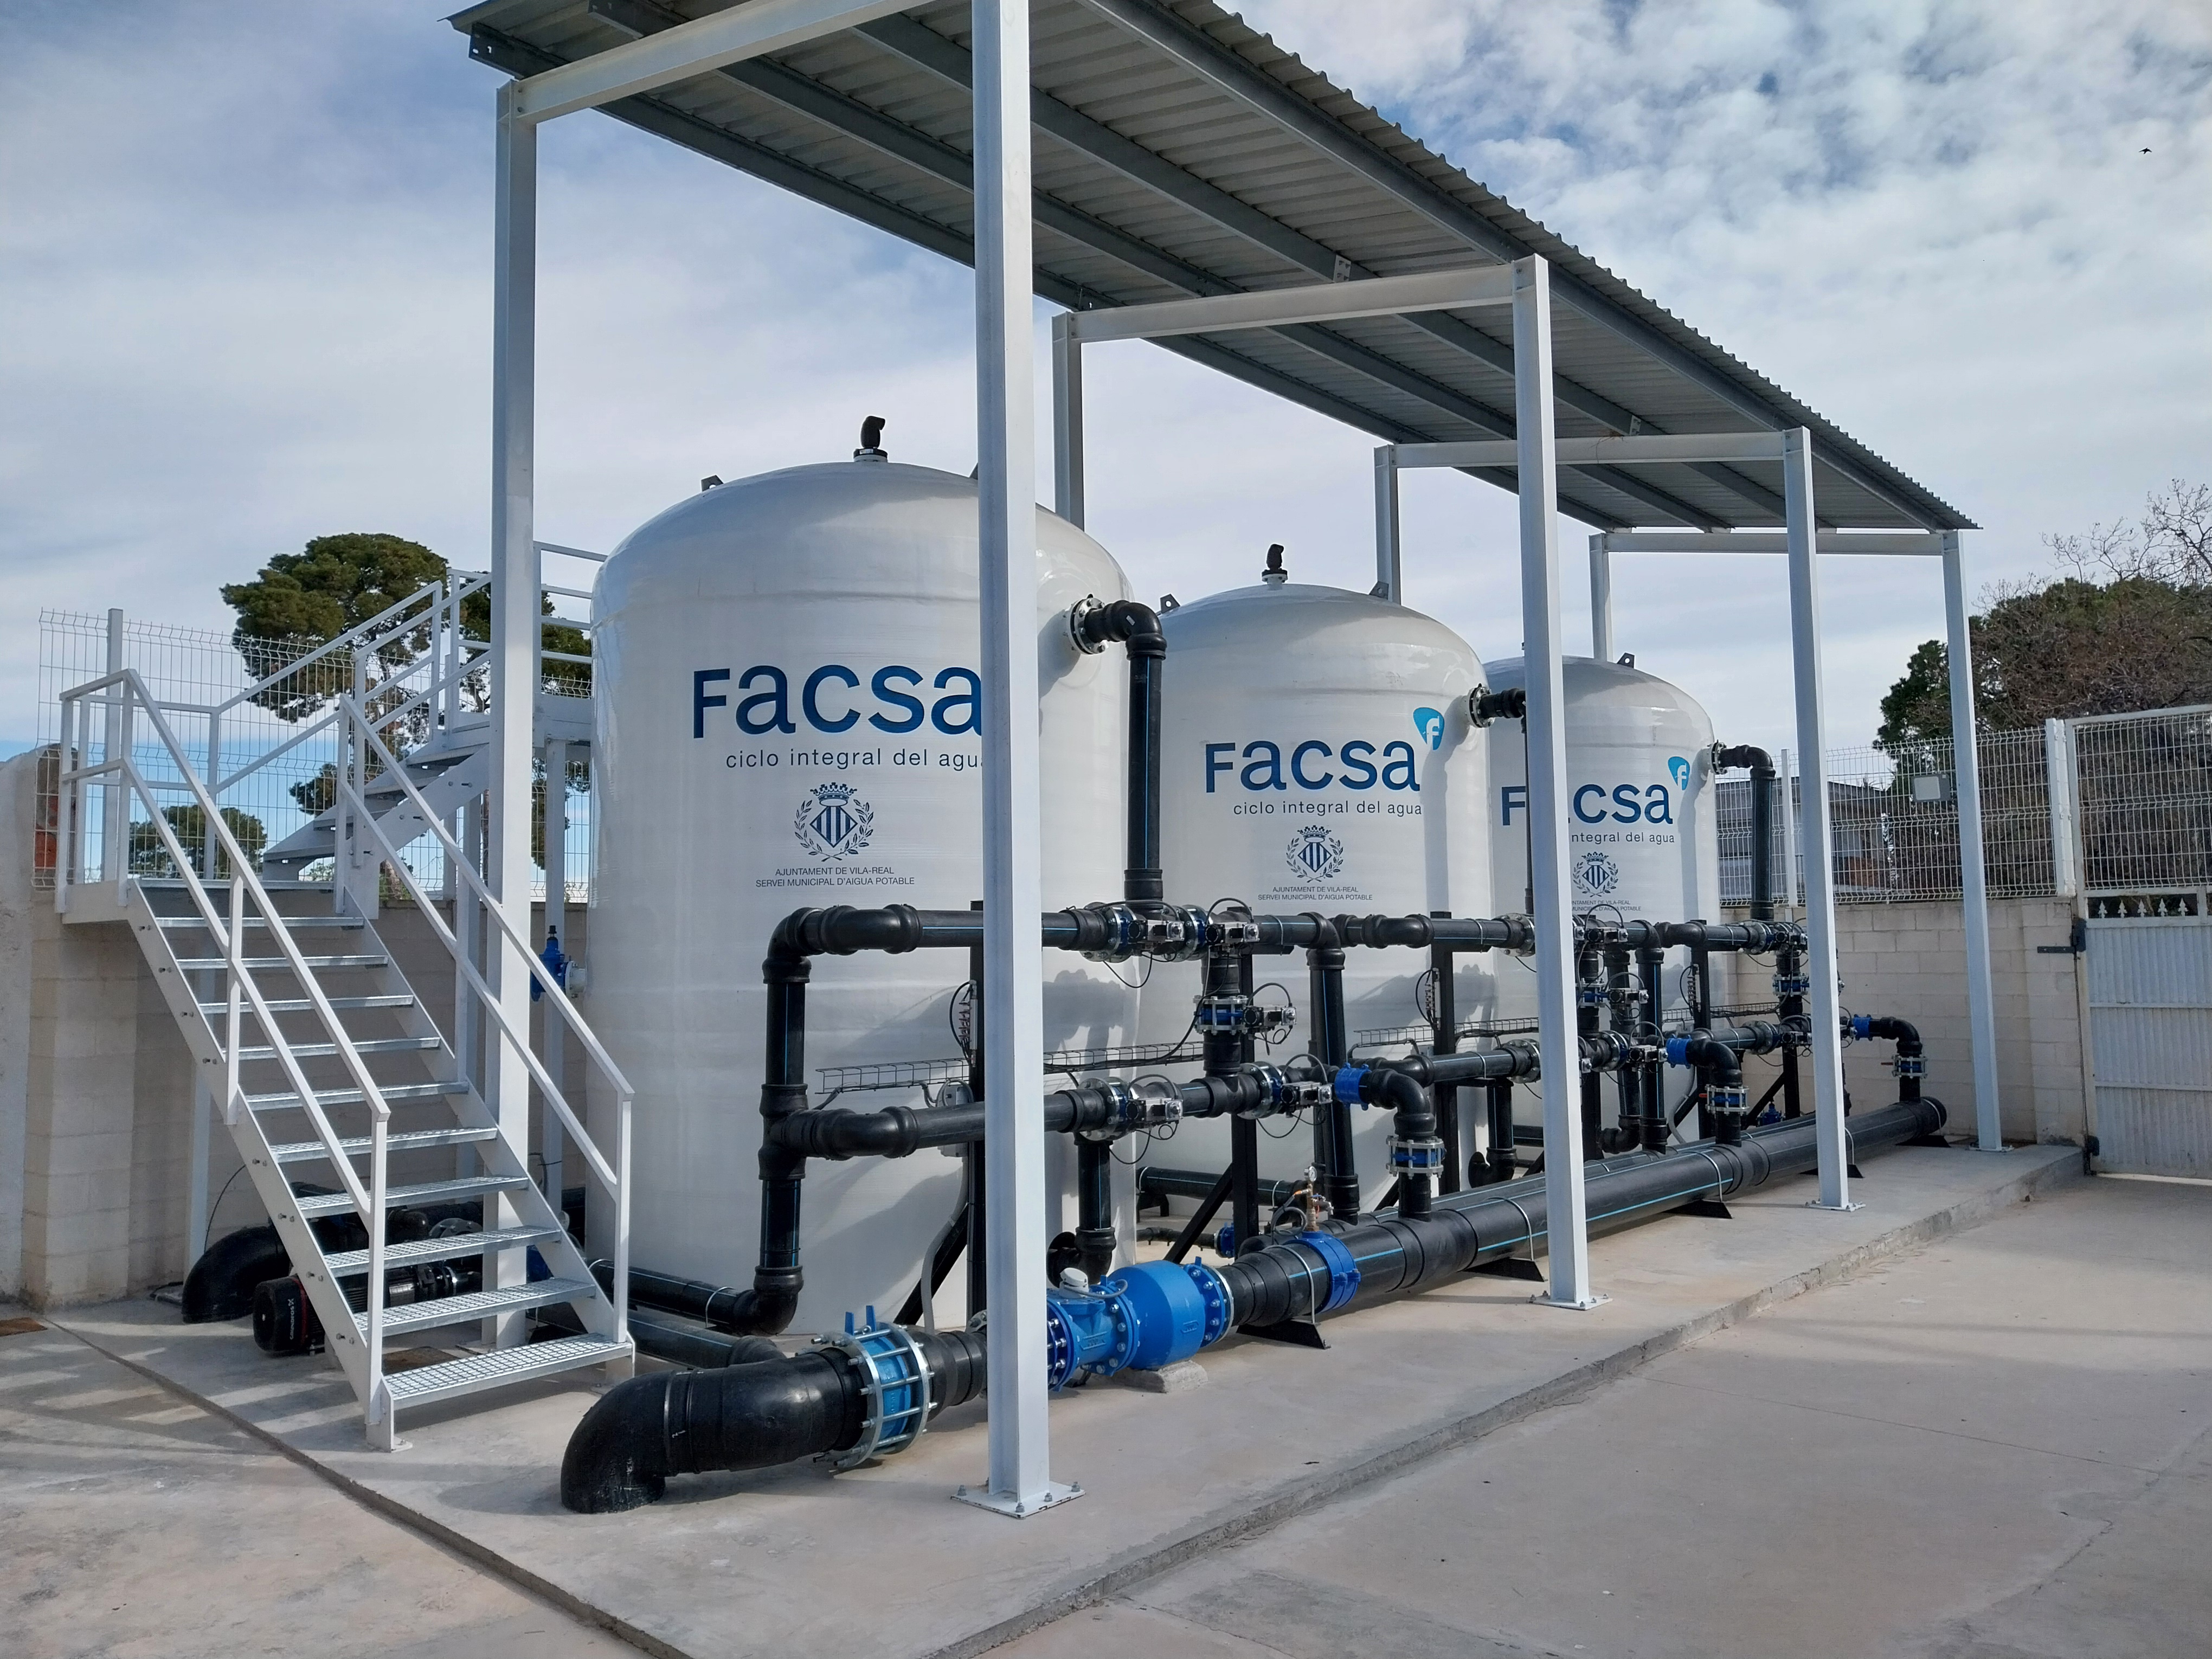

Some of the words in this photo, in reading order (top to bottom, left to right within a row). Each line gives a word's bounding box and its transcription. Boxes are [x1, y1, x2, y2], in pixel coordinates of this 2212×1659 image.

[693, 665, 981, 738] Facsa
[726, 749, 779, 768] ciclo
[790, 748, 880, 770] integral
[893, 748, 927, 766] del
[938, 754, 982, 771] agu
[1205, 740, 1420, 793] Facsa
[1233, 801, 1274, 815] ciclo
[1283, 800, 1348, 816] integral
[1356, 800, 1380, 814] del
[1387, 804, 1422, 818] agua
[1501, 784, 1673, 826] Fcsa
[1572, 832, 1619, 845] ntegral
[1625, 832, 1644, 843] del
[1649, 834, 1675, 845] agua
[775, 867, 833, 876] AJUNTAMENT
[756, 879, 785, 888] SERVEI
[787, 878, 835, 886] MUNICIPAL
[837, 877, 873, 885] D'AIGUA
[876, 877, 915, 885] POTABLE
